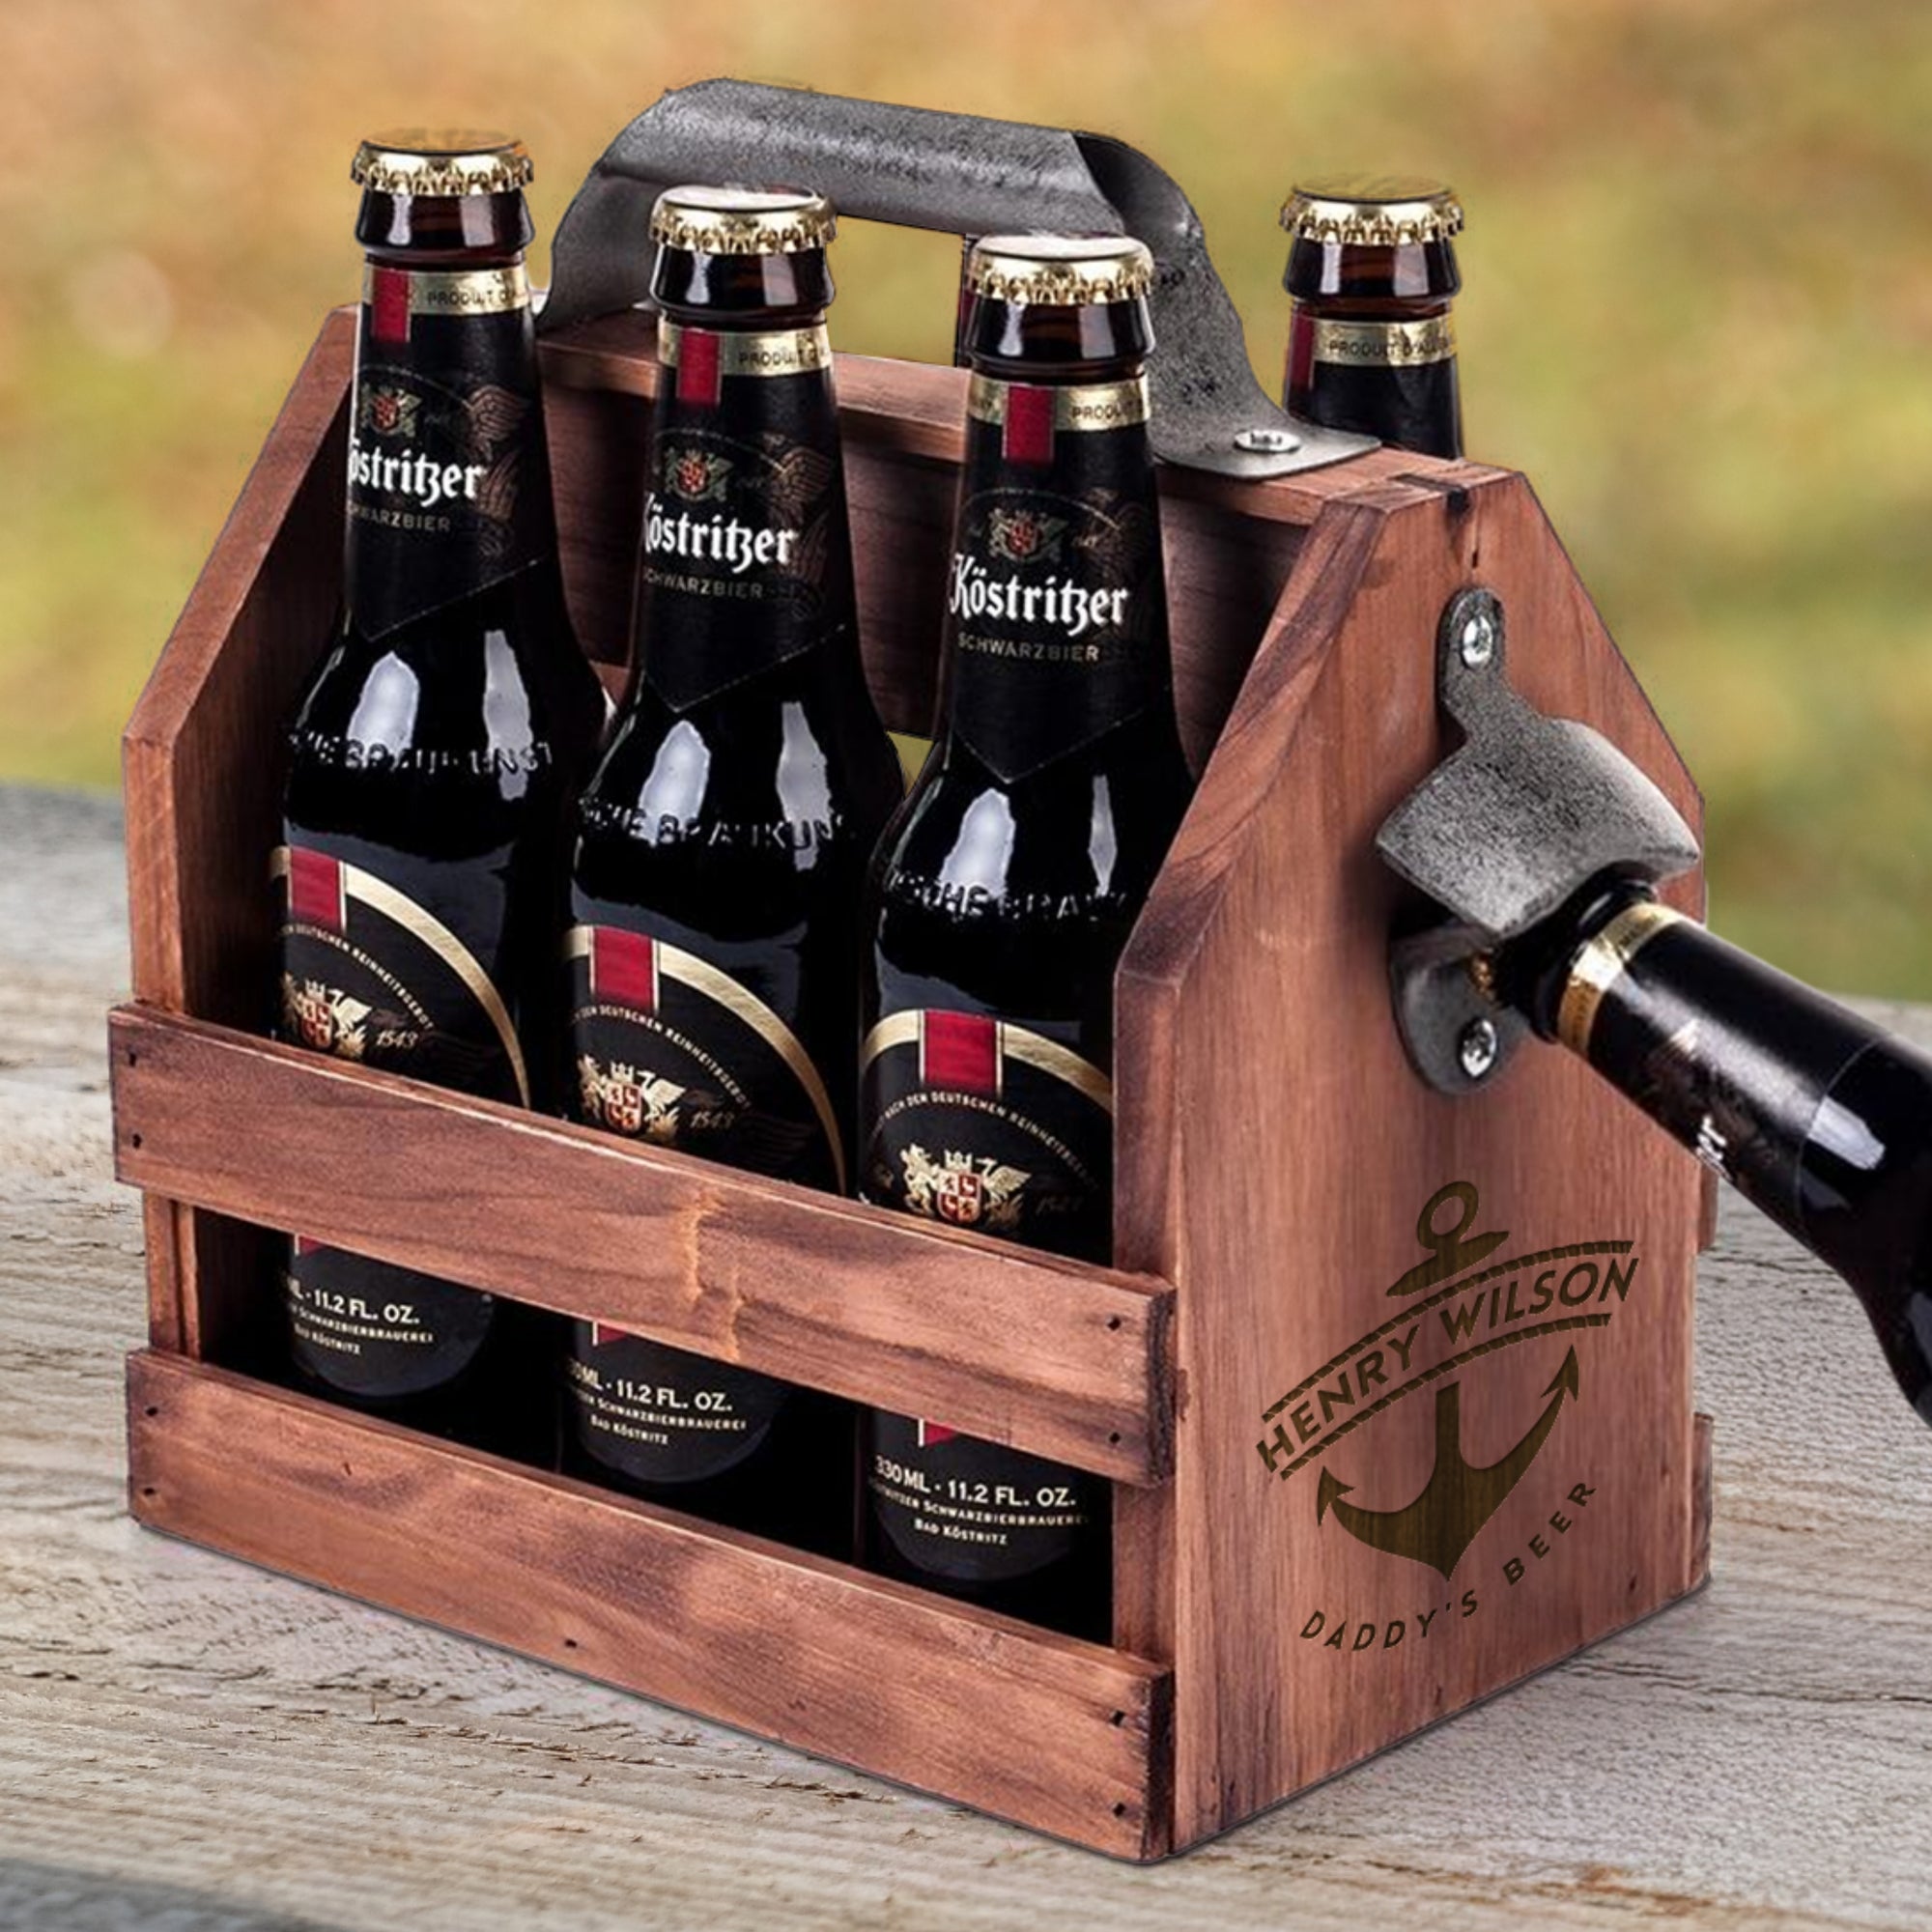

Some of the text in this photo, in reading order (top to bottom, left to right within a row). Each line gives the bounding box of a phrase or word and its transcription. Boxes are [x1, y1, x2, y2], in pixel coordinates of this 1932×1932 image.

[349, 438, 487, 507] östritzer
[957, 633, 1100, 662] SCHWARZBIER
[930, 1091, 1006, 1119] DEUTSCHEN
[349, 1298, 379, 1321] FL.
[384, 1304, 420, 1324] OZ.
[1256, 1258, 1640, 1473] HENRY WILSON
[616, 1378, 652, 1404] 11.2
[656, 1387, 689, 1410] FL.
[695, 1391, 733, 1411] OZ.
[948, 1479, 989, 1504] 11.2
[994, 1485, 1030, 1507] FL.
[1037, 1487, 1076, 1507] OZ.
[1300, 1482, 1596, 1652] DADDY'S BEER
